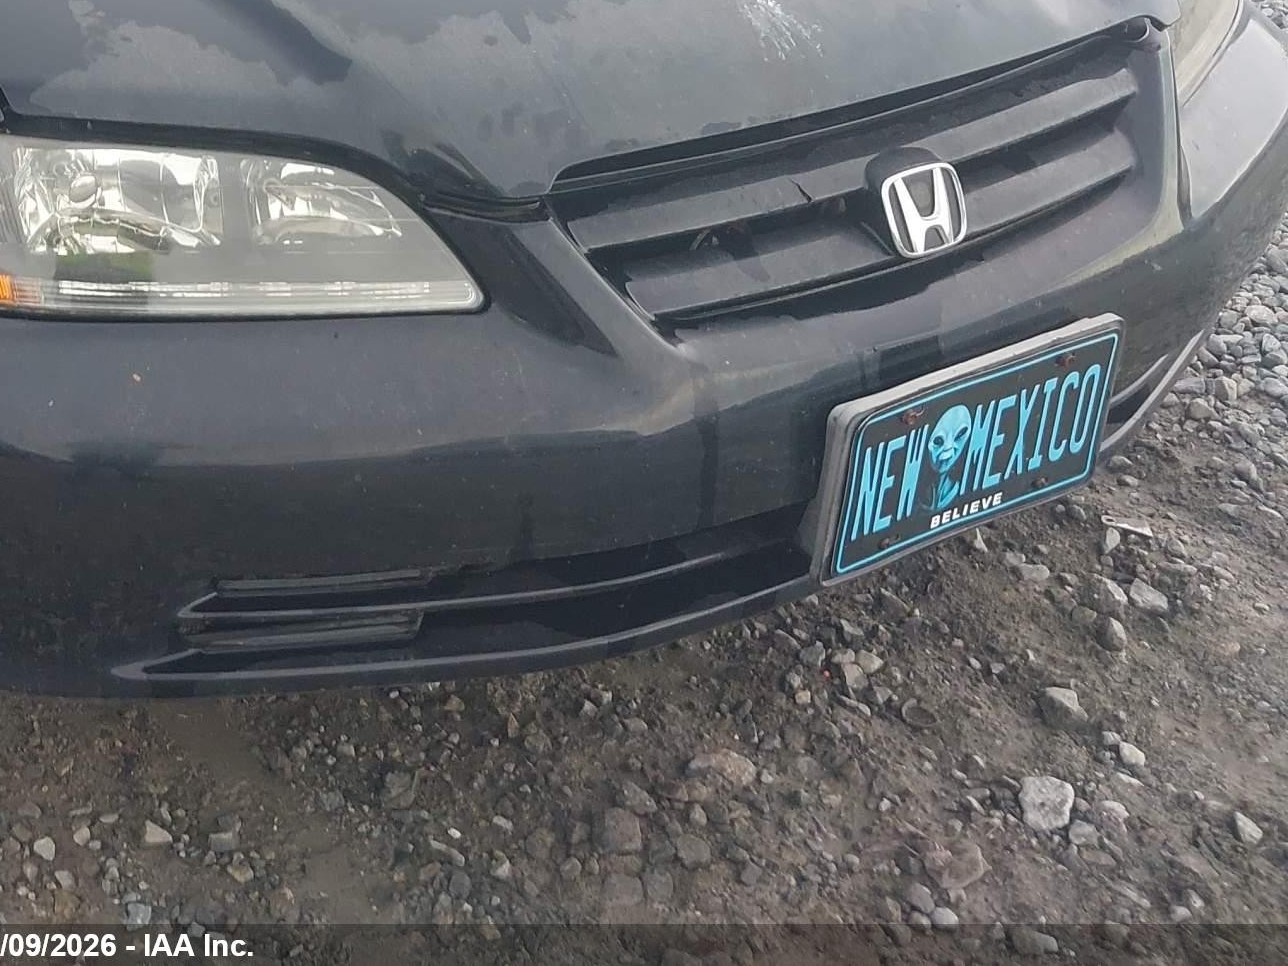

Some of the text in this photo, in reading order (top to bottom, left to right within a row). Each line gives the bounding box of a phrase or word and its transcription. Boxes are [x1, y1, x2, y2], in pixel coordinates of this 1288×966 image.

[850, 364, 1102, 543] NEW MEXICO
[929, 491, 1003, 530] BELIEVE
